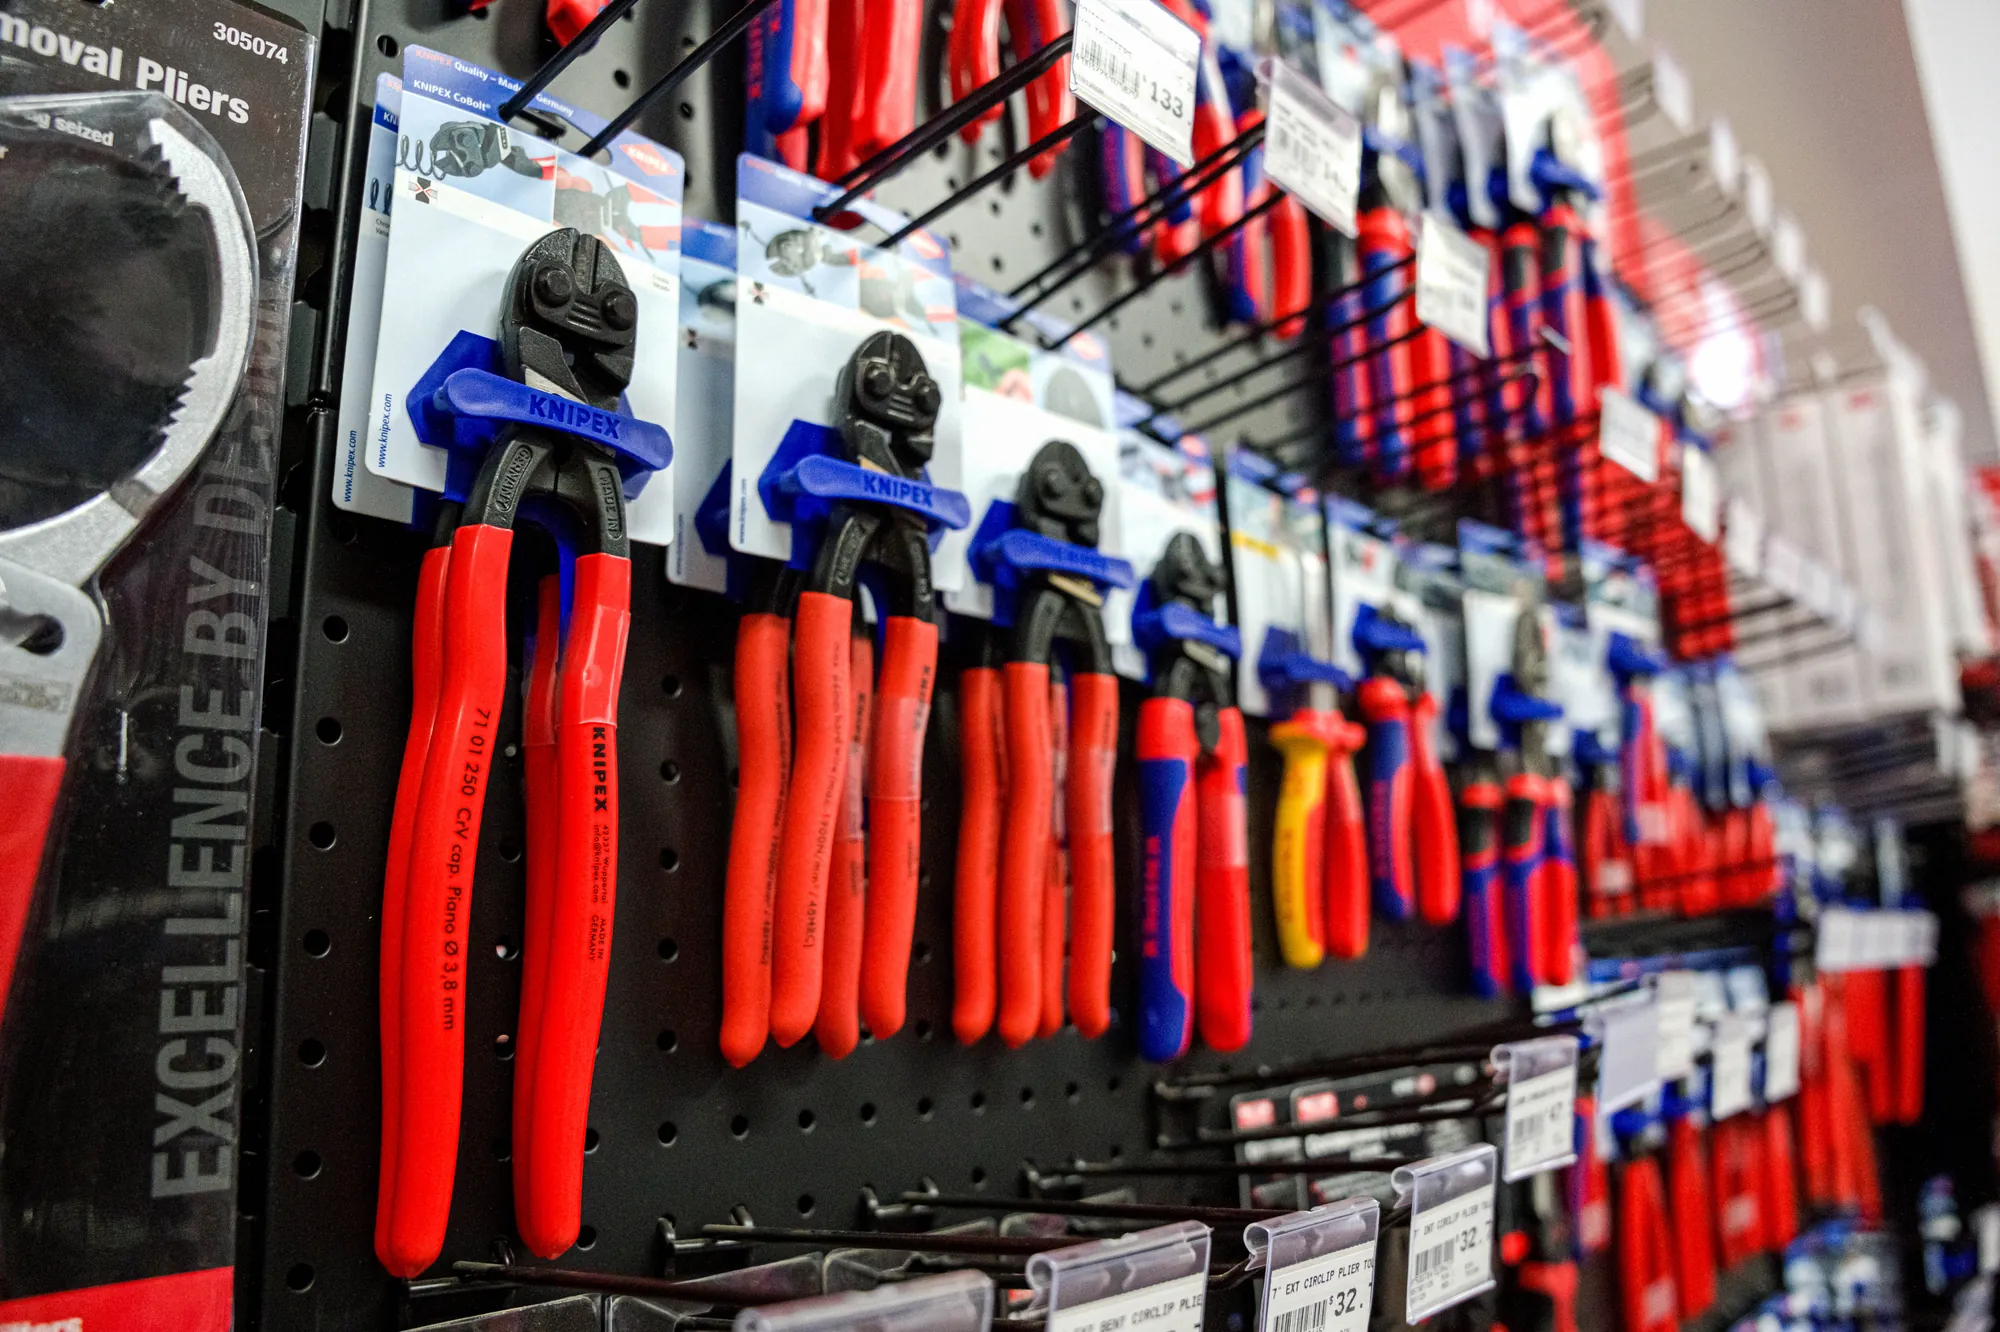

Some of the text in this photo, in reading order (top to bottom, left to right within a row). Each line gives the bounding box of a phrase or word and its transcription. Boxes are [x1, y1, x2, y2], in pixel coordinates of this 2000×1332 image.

[212, 21, 289, 65] 305074
[413, 79, 451, 100] KNIPEX
[454, 61, 489, 82] Quality
[135, 55, 250, 125] Pliers
[54, 117, 115, 148] seized
[377, 392, 393, 468] www.knipex.com
[528, 393, 622, 440] KNIPEX
[343, 429, 358, 503] www.knipex.com
[496, 449, 531, 510] GERMANY
[862, 475, 935, 509] KNIPEX
[183, 554, 262, 660] BY
[472, 706, 492, 728] 71
[470, 734, 486, 758] 01
[460, 761, 481, 797] 250
[592, 726, 609, 812] KNIPEX
[455, 806, 472, 841] CrV
[449, 843, 463, 877] cap.
[445, 885, 463, 936] Piano
[151, 683, 256, 1198] EXCELLENCE
[588, 914, 599, 963] GERMANY
[597, 917, 607, 960] MADE IN
[441, 959, 459, 992] 3,8
[442, 995, 456, 1031] mm
[1285, 1280, 1301, 1296] EXT
[1303, 1269, 1336, 1290] CIRCLIP
[1337, 1262, 1360, 1279] PLIER
[1130, 1301, 1175, 1325] CIRCLIP
